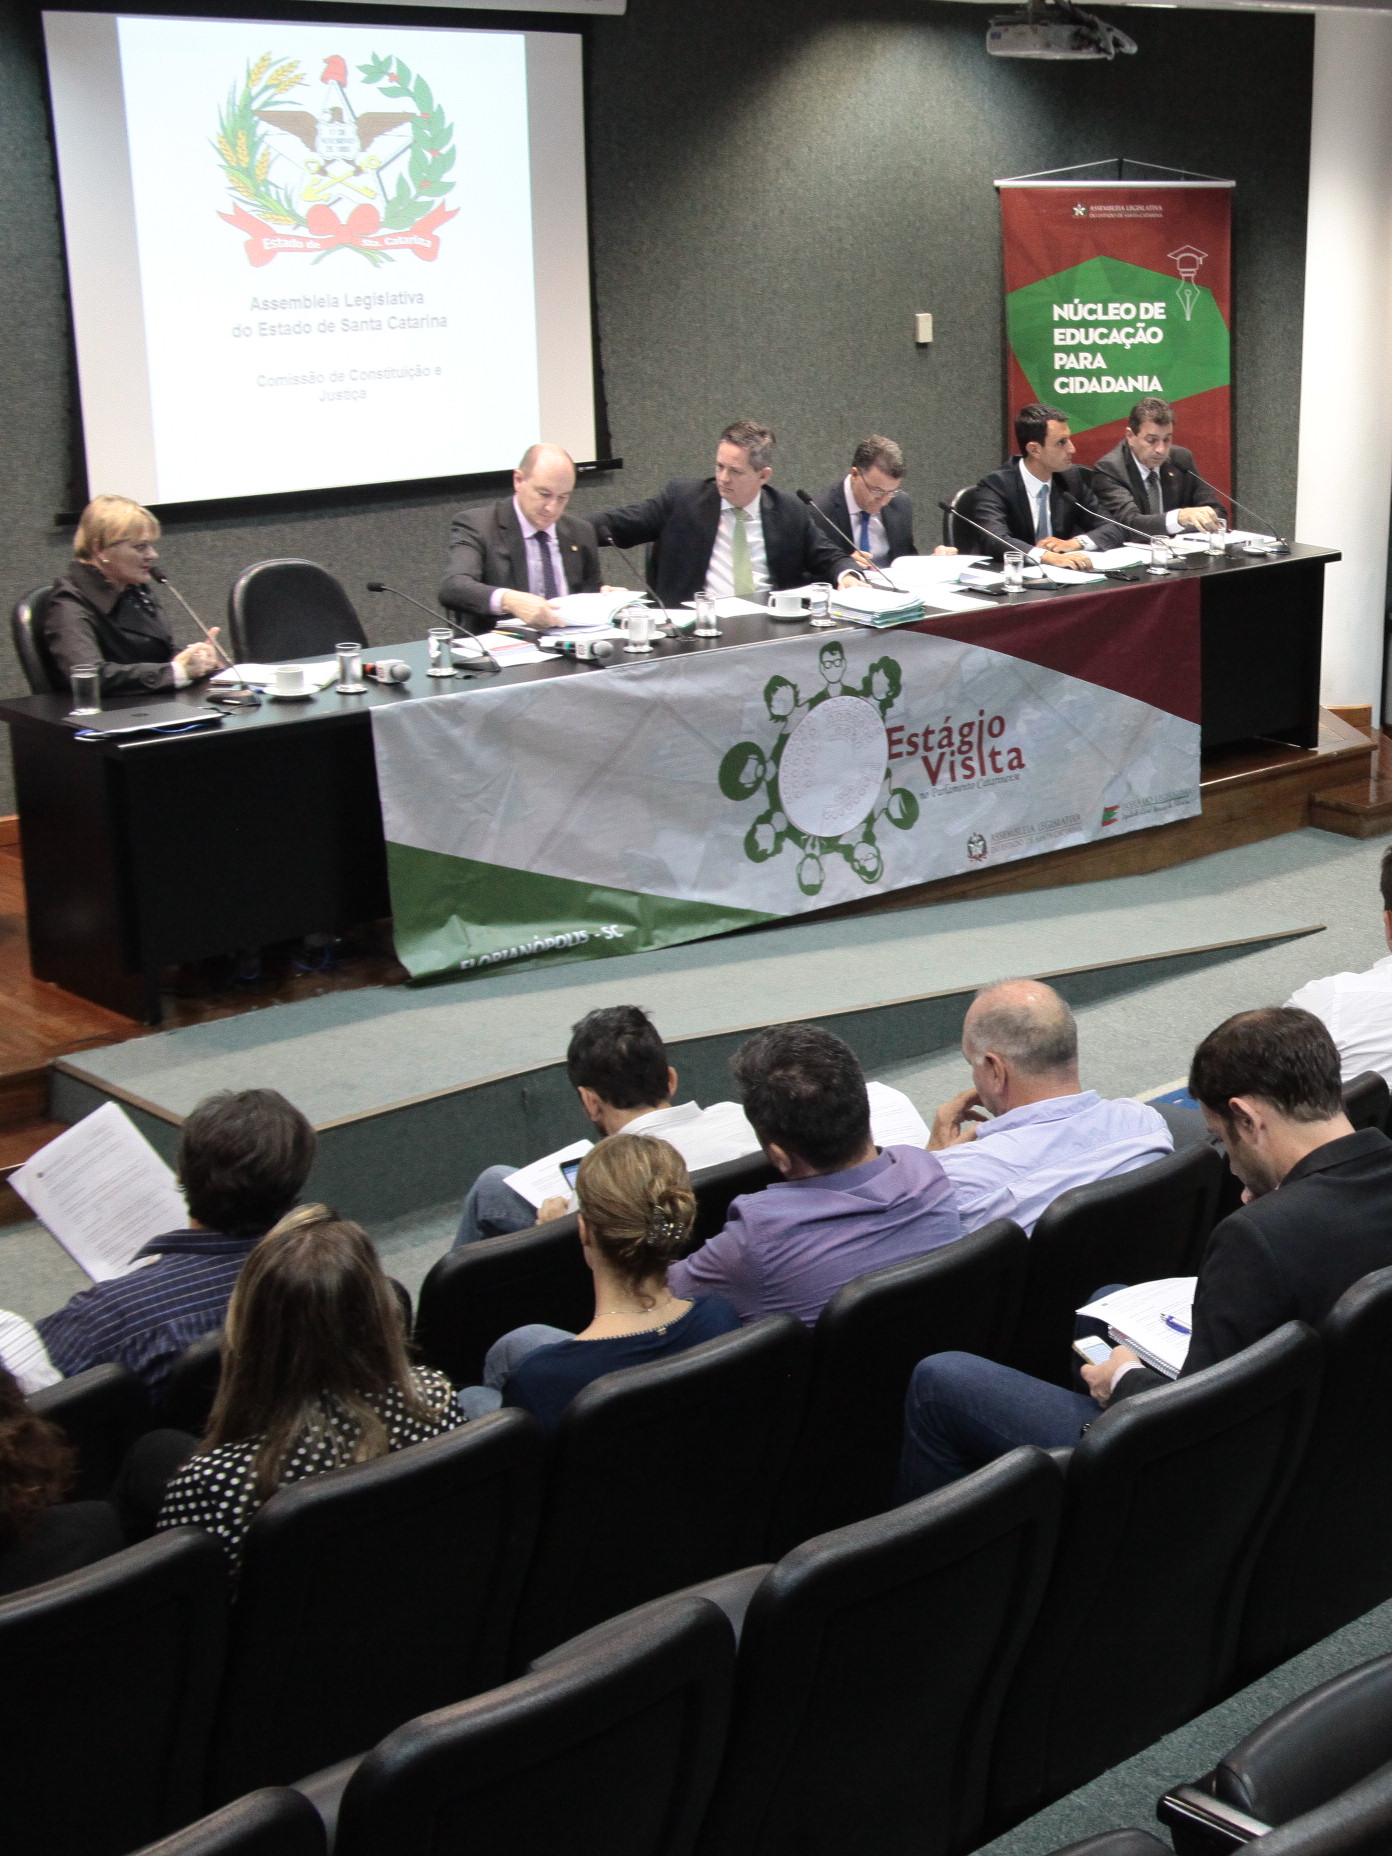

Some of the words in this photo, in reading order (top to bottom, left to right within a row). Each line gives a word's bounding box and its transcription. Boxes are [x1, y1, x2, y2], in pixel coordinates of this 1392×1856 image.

[249, 293, 341, 312] Assembleia
[344, 290, 425, 311] Legislativa
[1052, 298, 1138, 321] NÚCLEO
[1139, 302, 1167, 320] DE
[231, 323, 253, 339] do
[258, 319, 312, 337] Estado
[317, 318, 336, 334] de
[340, 317, 383, 333] Santa
[387, 314, 448, 330] Catarina
[1053, 322, 1164, 350] EDUCAÇÃO
[1053, 352, 1108, 370] PARA
[256, 370, 325, 388] Comissão
[329, 369, 346, 384] de
[348, 363, 431, 382] Constituição
[434, 365, 443, 376] e
[1053, 375, 1164, 394] CIDADANIA
[318, 387, 368, 403] Justiça
[886, 709, 1006, 760] Estágio
[921, 745, 1026, 786] Visita
[459, 930, 590, 970] FLORIANÓPOLIS
[601, 924, 625, 940] SC
